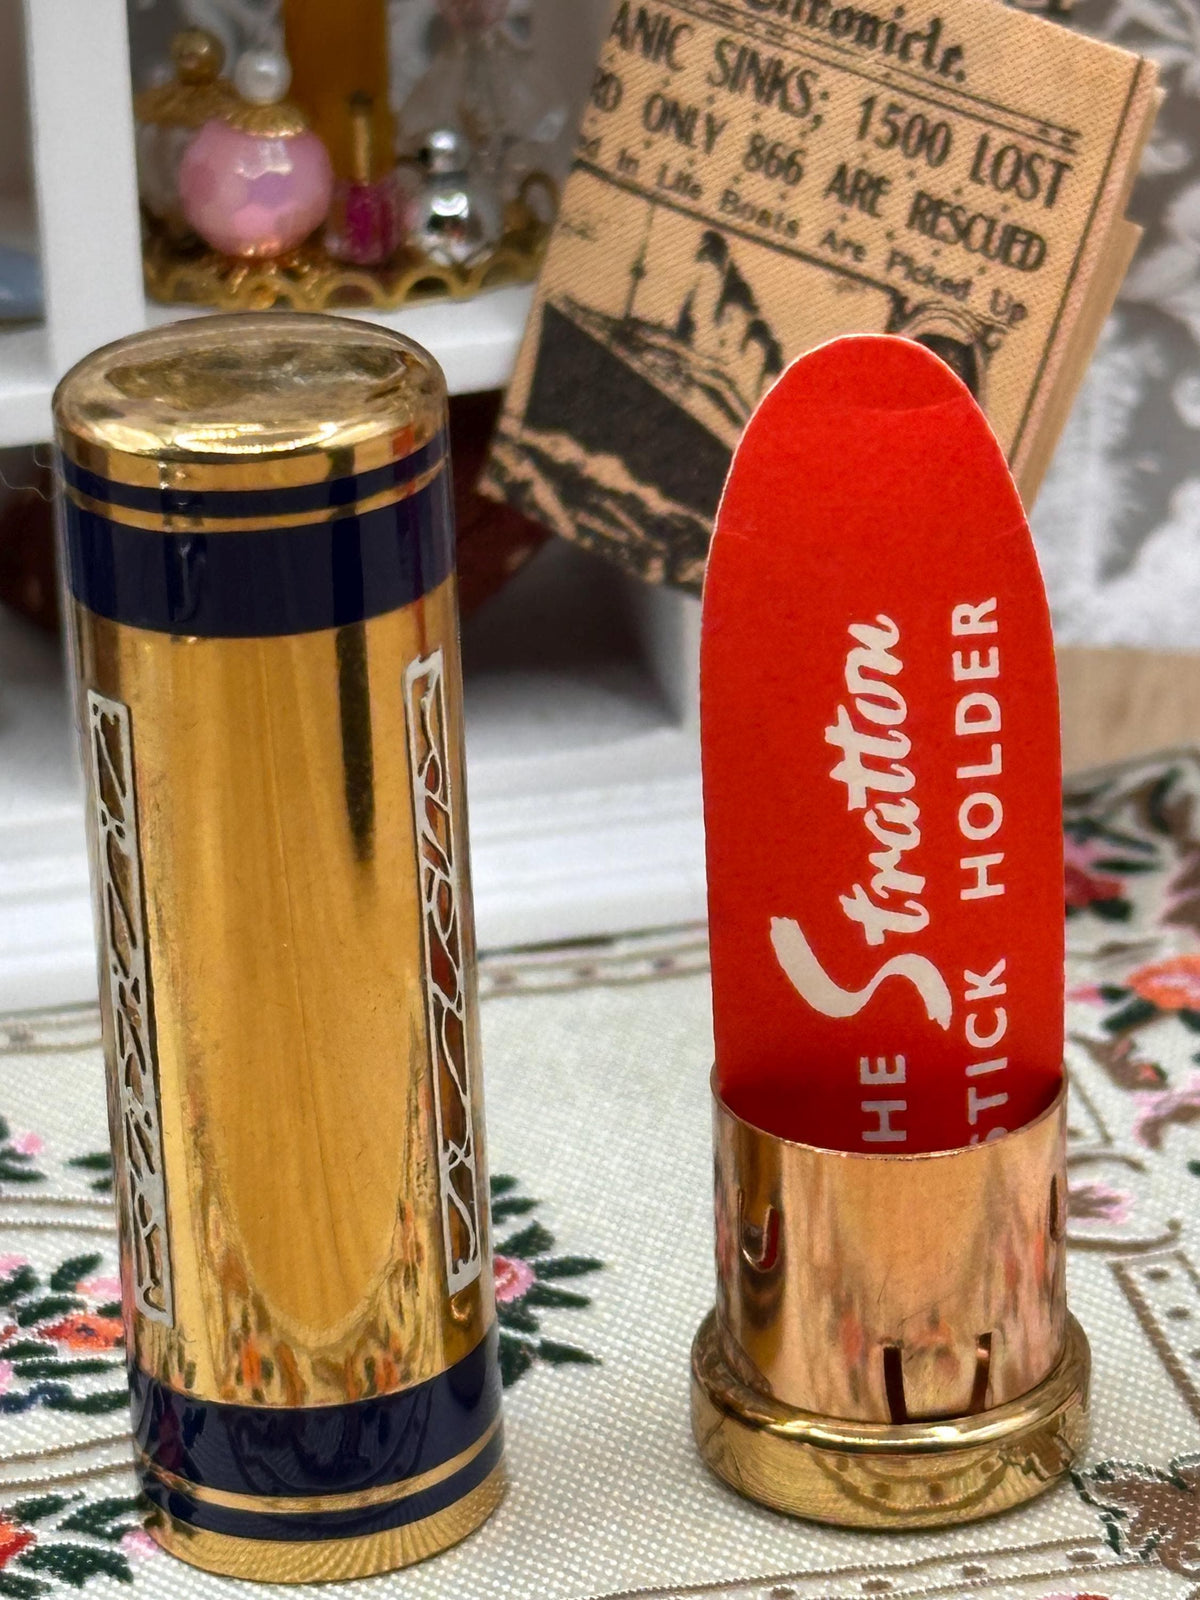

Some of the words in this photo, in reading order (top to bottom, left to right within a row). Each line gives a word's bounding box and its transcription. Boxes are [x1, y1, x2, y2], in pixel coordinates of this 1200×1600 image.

[707, 37, 829, 138] SINKS;
[855, 95, 953, 169] 1500
[969, 132, 1074, 209] LOST
[746, 0, 966, 83] ronicle.
[642, 92, 728, 156] ONLY
[742, 132, 806, 187] 866
[822, 161, 892, 218] ARE
[905, 189, 1048, 273] RESCUED
[718, 188, 801, 240] Boats
[819, 229, 867, 263] Are
[886, 247, 973, 300] Picked
[989, 287, 1029, 328] Up
[769, 614, 952, 1031] Stratton
[951, 597, 1005, 900] HOLDER
